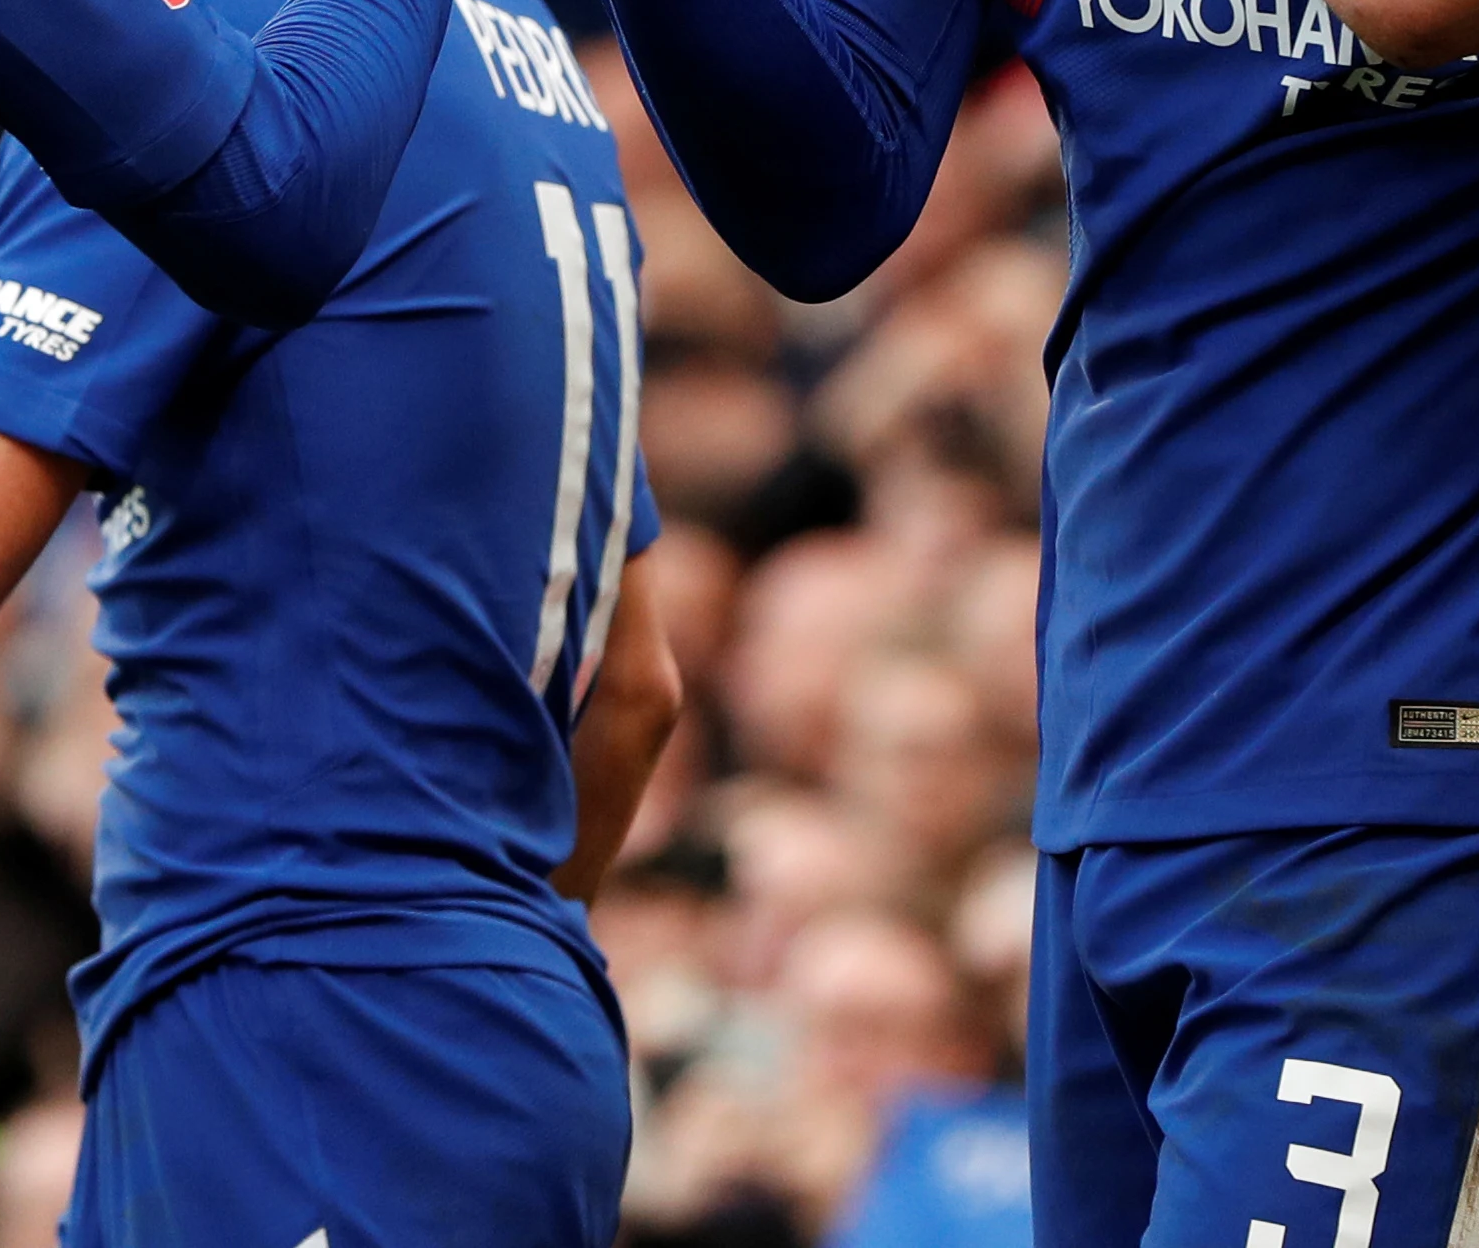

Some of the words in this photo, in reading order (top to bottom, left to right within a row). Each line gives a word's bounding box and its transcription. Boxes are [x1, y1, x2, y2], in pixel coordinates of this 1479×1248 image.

[534, 182, 640, 710] 11
[1403, 710, 1455, 720] AUTHENTIC
[1246, 1058, 1401, 1248] 3
